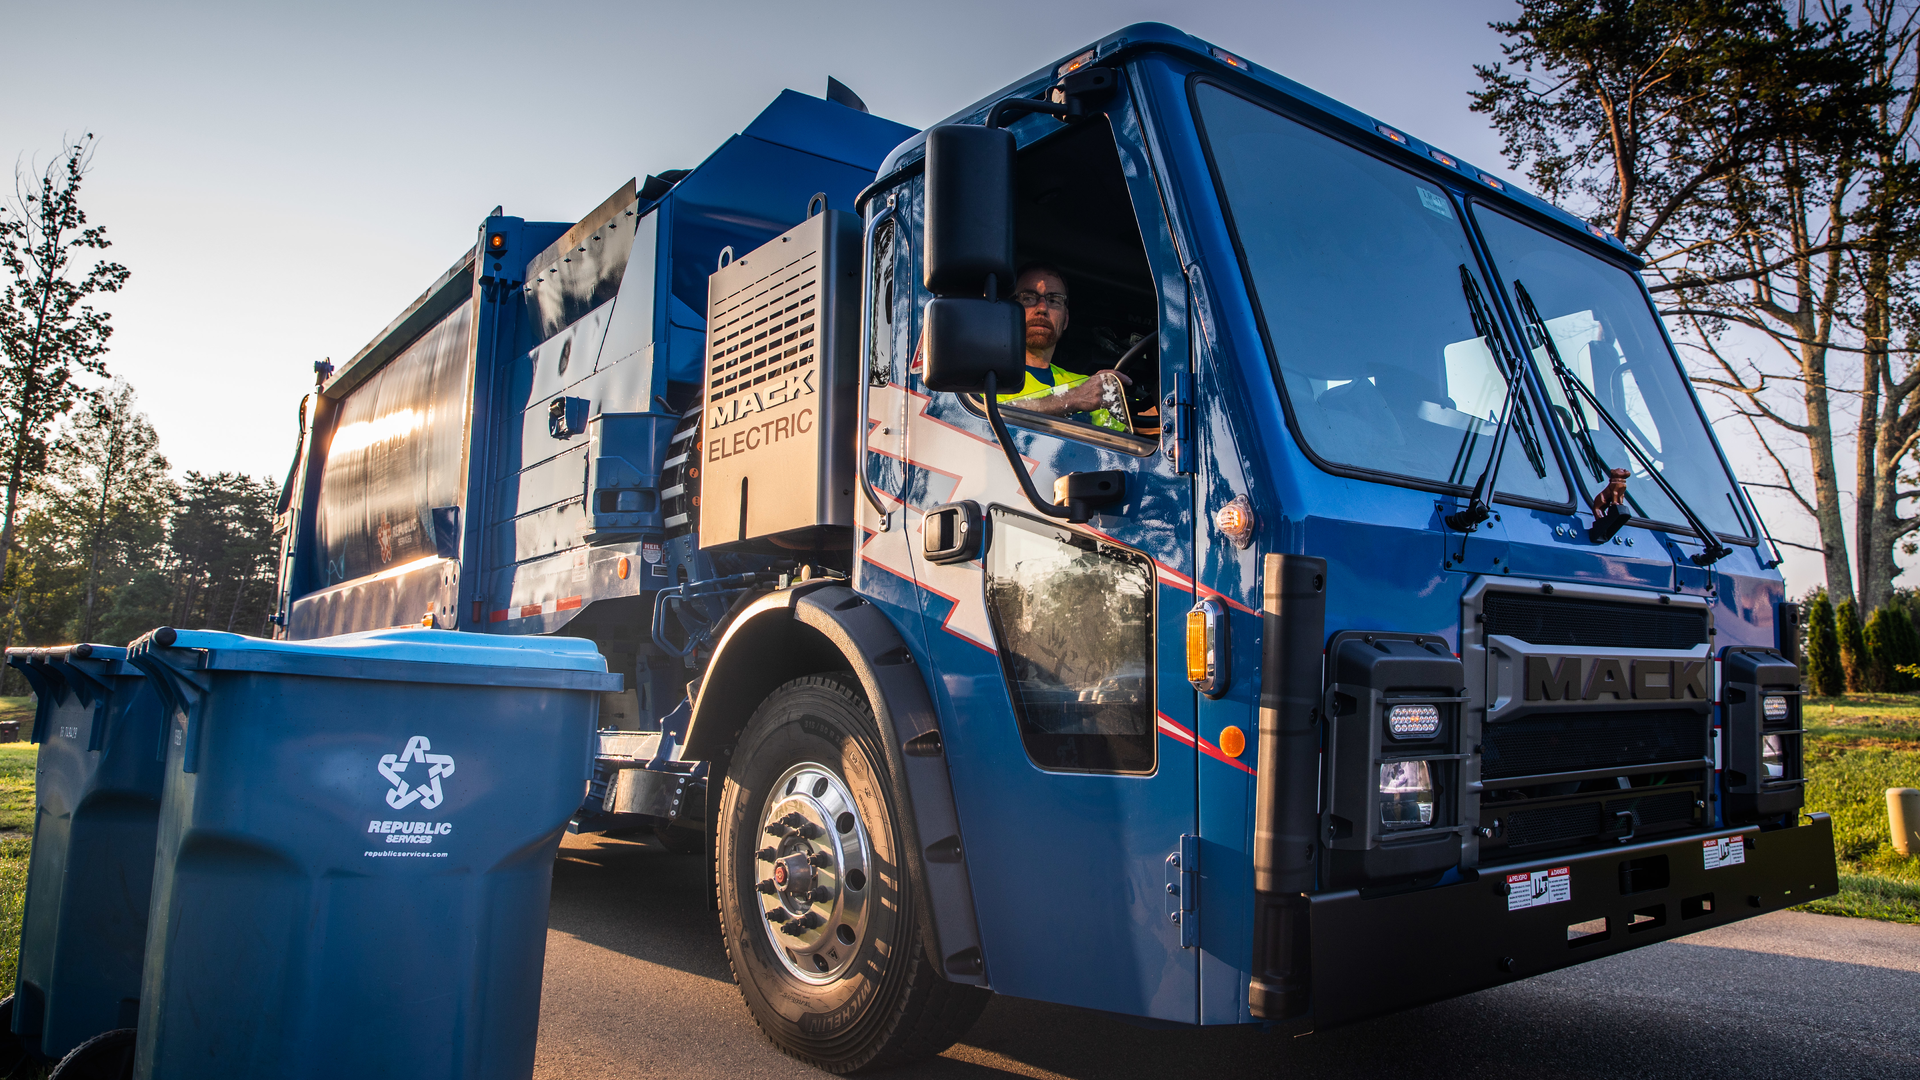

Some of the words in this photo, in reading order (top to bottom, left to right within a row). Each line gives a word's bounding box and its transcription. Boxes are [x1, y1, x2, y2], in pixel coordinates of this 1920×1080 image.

[709, 369, 815, 430] MACK
[708, 408, 813, 463] ELECTRIC
[392, 519, 417, 538] REPUBLIC
[397, 534, 412, 546] SERVICES
[1524, 655, 1707, 701] MACK
[367, 820, 453, 835] REPUBLIC
[385, 834, 433, 844] SERVICES
[363, 850, 449, 859] republicservices.com
[1512, 873, 1528, 881] PELIGRO
[1553, 867, 1568, 875] DANGER
[809, 978, 871, 1032] MICHELIN
